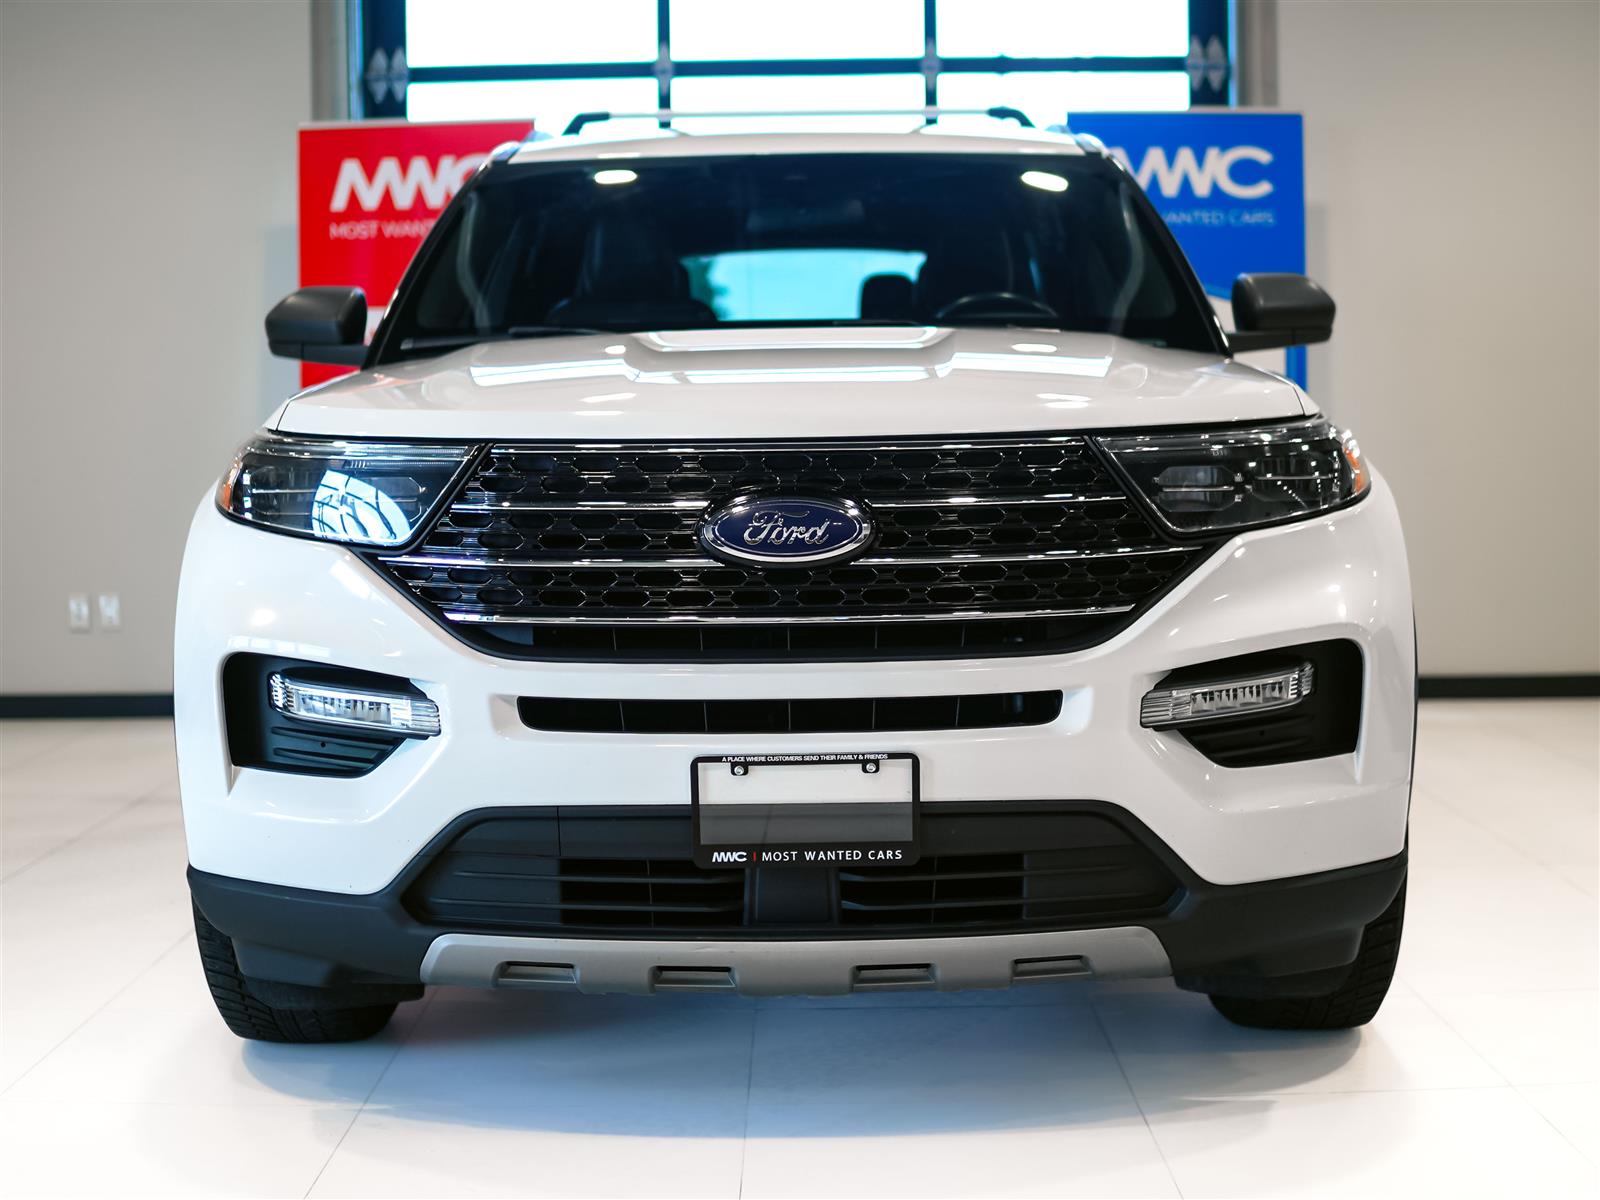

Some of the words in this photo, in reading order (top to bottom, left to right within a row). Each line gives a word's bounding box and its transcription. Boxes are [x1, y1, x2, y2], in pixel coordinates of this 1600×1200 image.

[1229, 208, 1274, 226] CARS
[329, 221, 379, 240] MOST
[743, 510, 831, 545] Ford
[711, 851, 748, 863] MWC
[761, 851, 798, 862] MOST
[804, 850, 862, 861] WANTED
[868, 849, 903, 860] CARS
